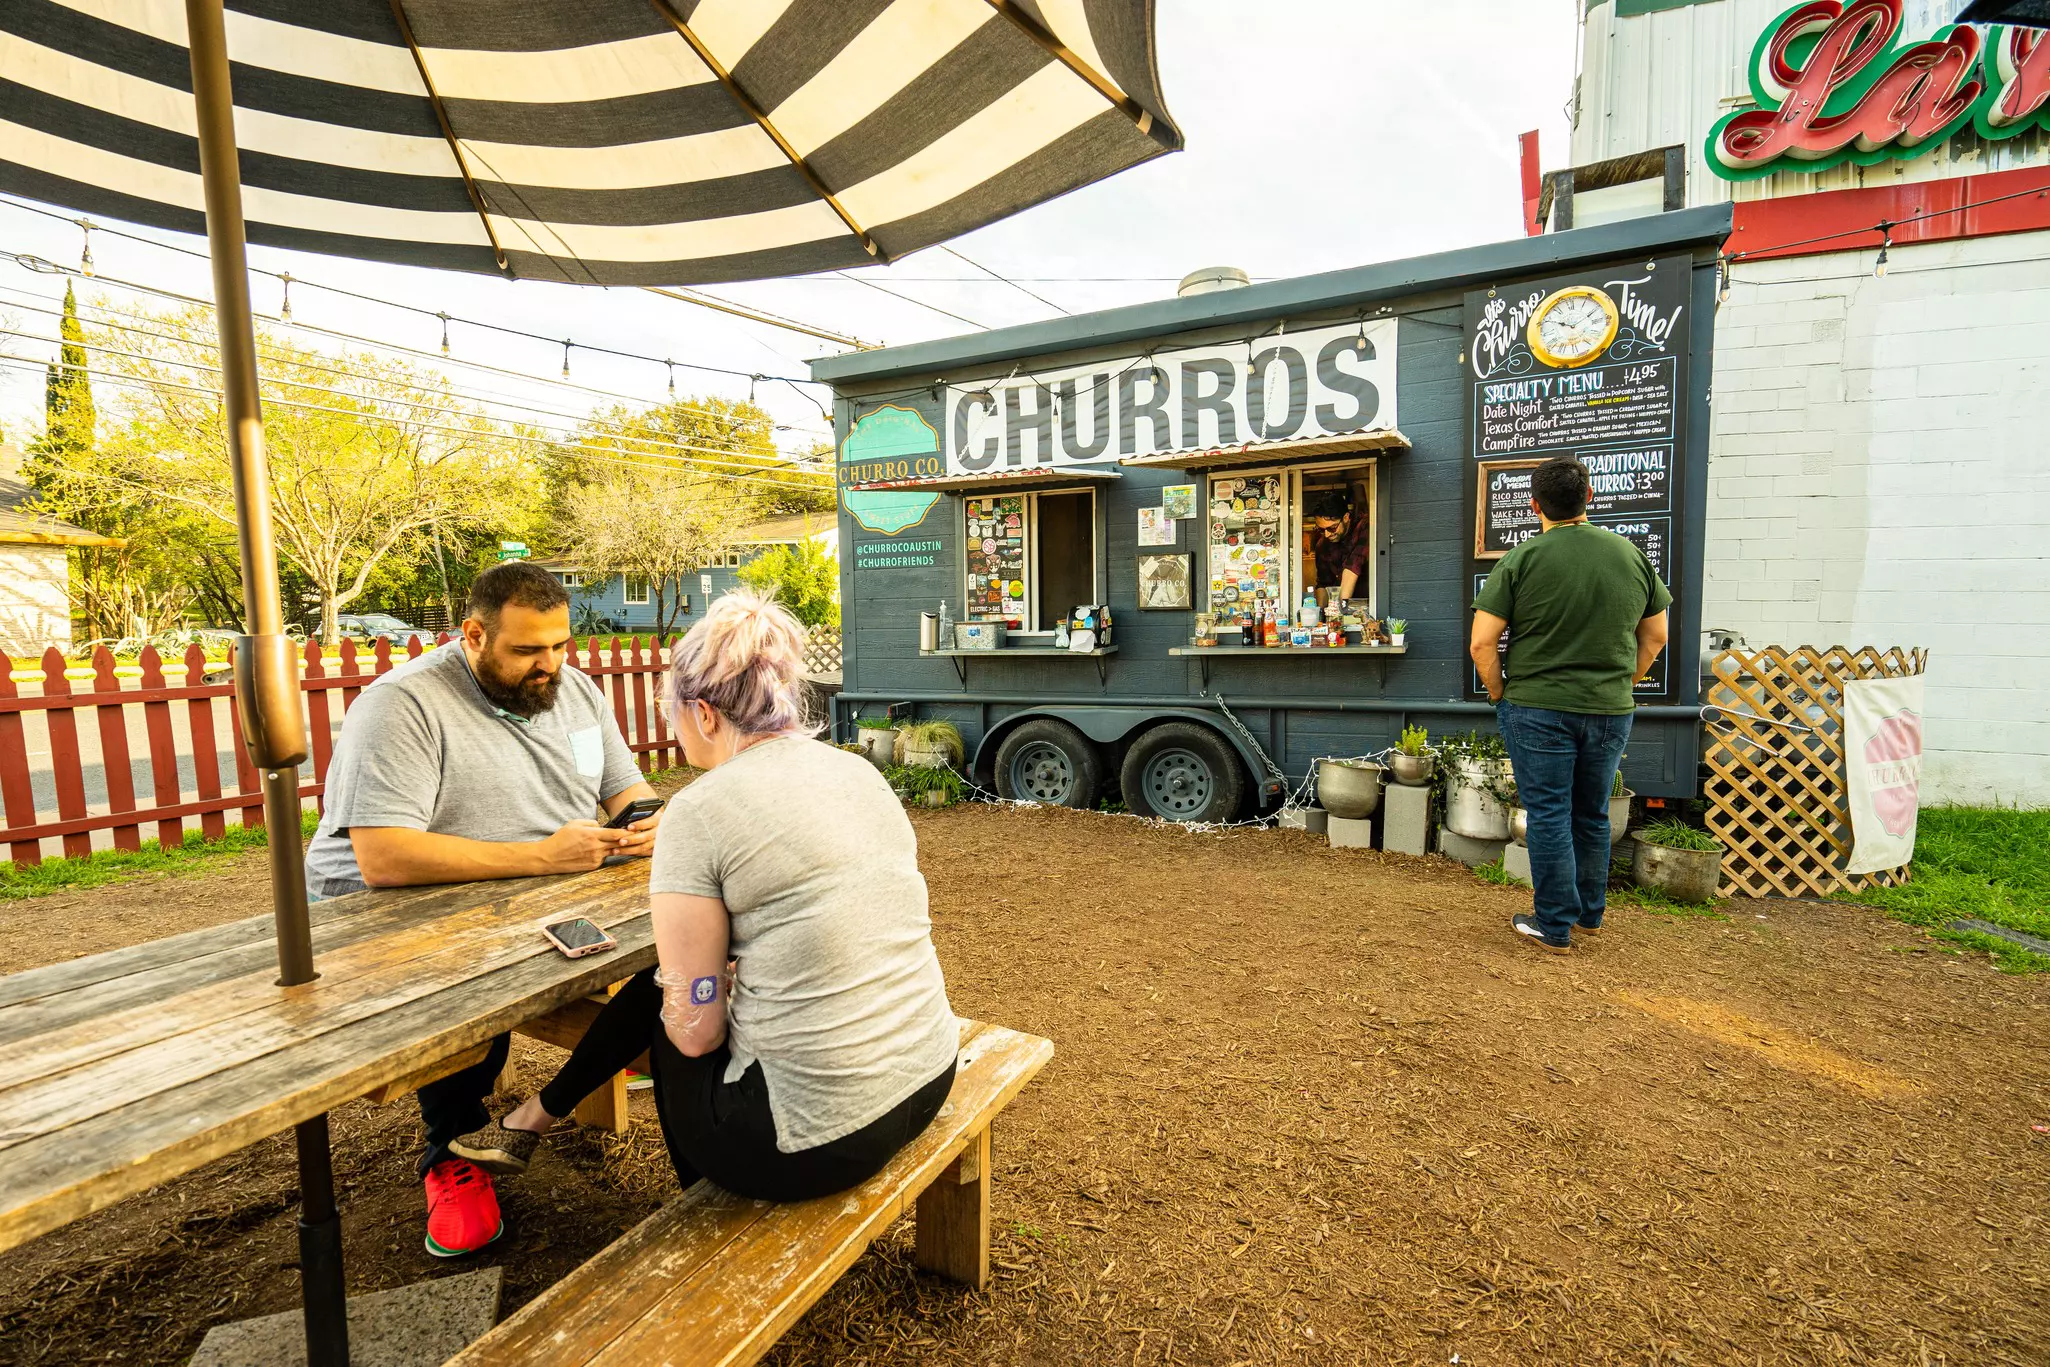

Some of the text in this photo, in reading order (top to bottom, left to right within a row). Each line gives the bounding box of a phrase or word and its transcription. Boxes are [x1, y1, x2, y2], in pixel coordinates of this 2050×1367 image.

[1709, 0, 1982, 175] La
[1603, 275, 1683, 352] Time!
[1472, 289, 1546, 379] Churro
[1484, 378, 1553, 404] SPECIALTY
[1558, 371, 1604, 395] MENU
[953, 335, 1380, 471] CHURROS
[1483, 399, 1543, 419] Date Night
[1483, 413, 1559, 436] Texas Comfort
[1482, 433, 1535, 451] Campfire
[838, 457, 945, 484] CHURRO CO.
[1580, 450, 1666, 474] TRADITIONAL
[1506, 481, 1532, 490] MENU
[1589, 472, 1636, 493] HURROS
[1492, 491, 1533, 501] RICO SUAV
[1491, 509, 1538, 519] WAKE-N-BA
[856, 540, 942, 555] @CHURROCOAUSTIN
[857, 556, 934, 568] #CHURROFRIENDS
[970, 605, 988, 613] ELECTRIC
